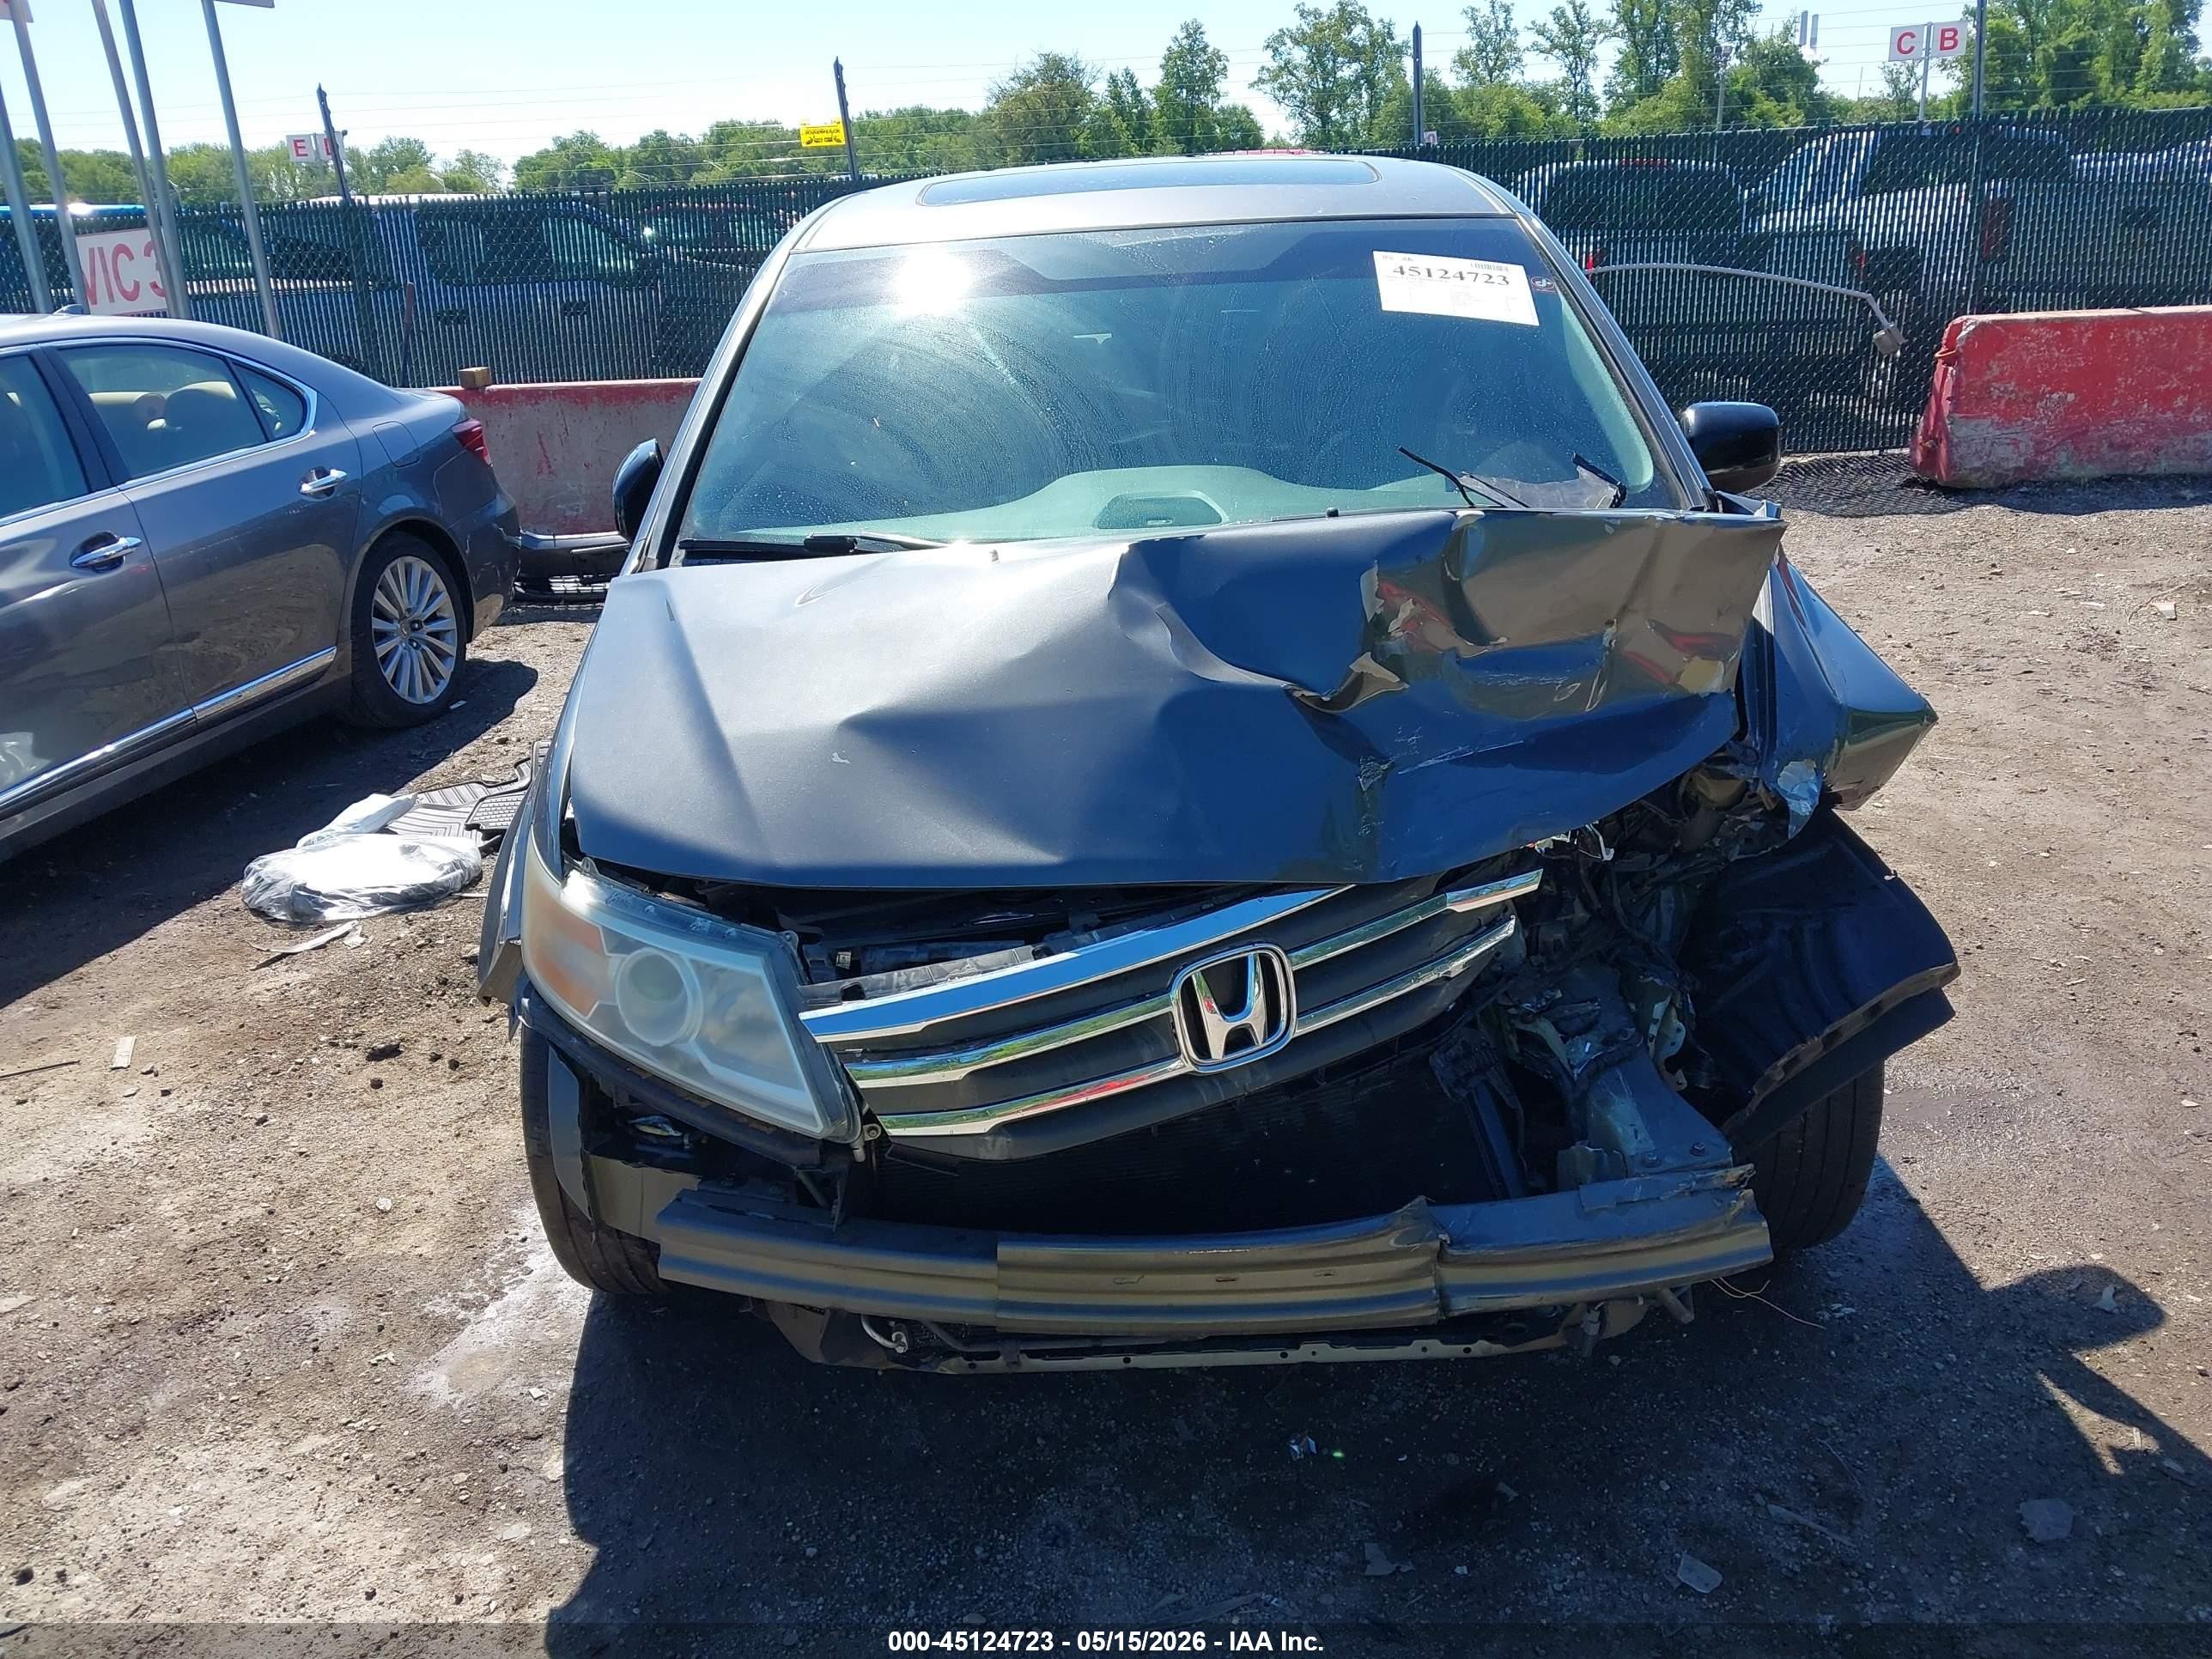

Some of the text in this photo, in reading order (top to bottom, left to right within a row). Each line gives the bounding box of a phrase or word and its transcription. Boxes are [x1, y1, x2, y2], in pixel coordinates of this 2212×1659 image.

[1897, 32, 1916, 54] C
[1940, 27, 1959, 51] B
[293, 139, 309, 157] E
[1393, 264, 1510, 287] 45124723
